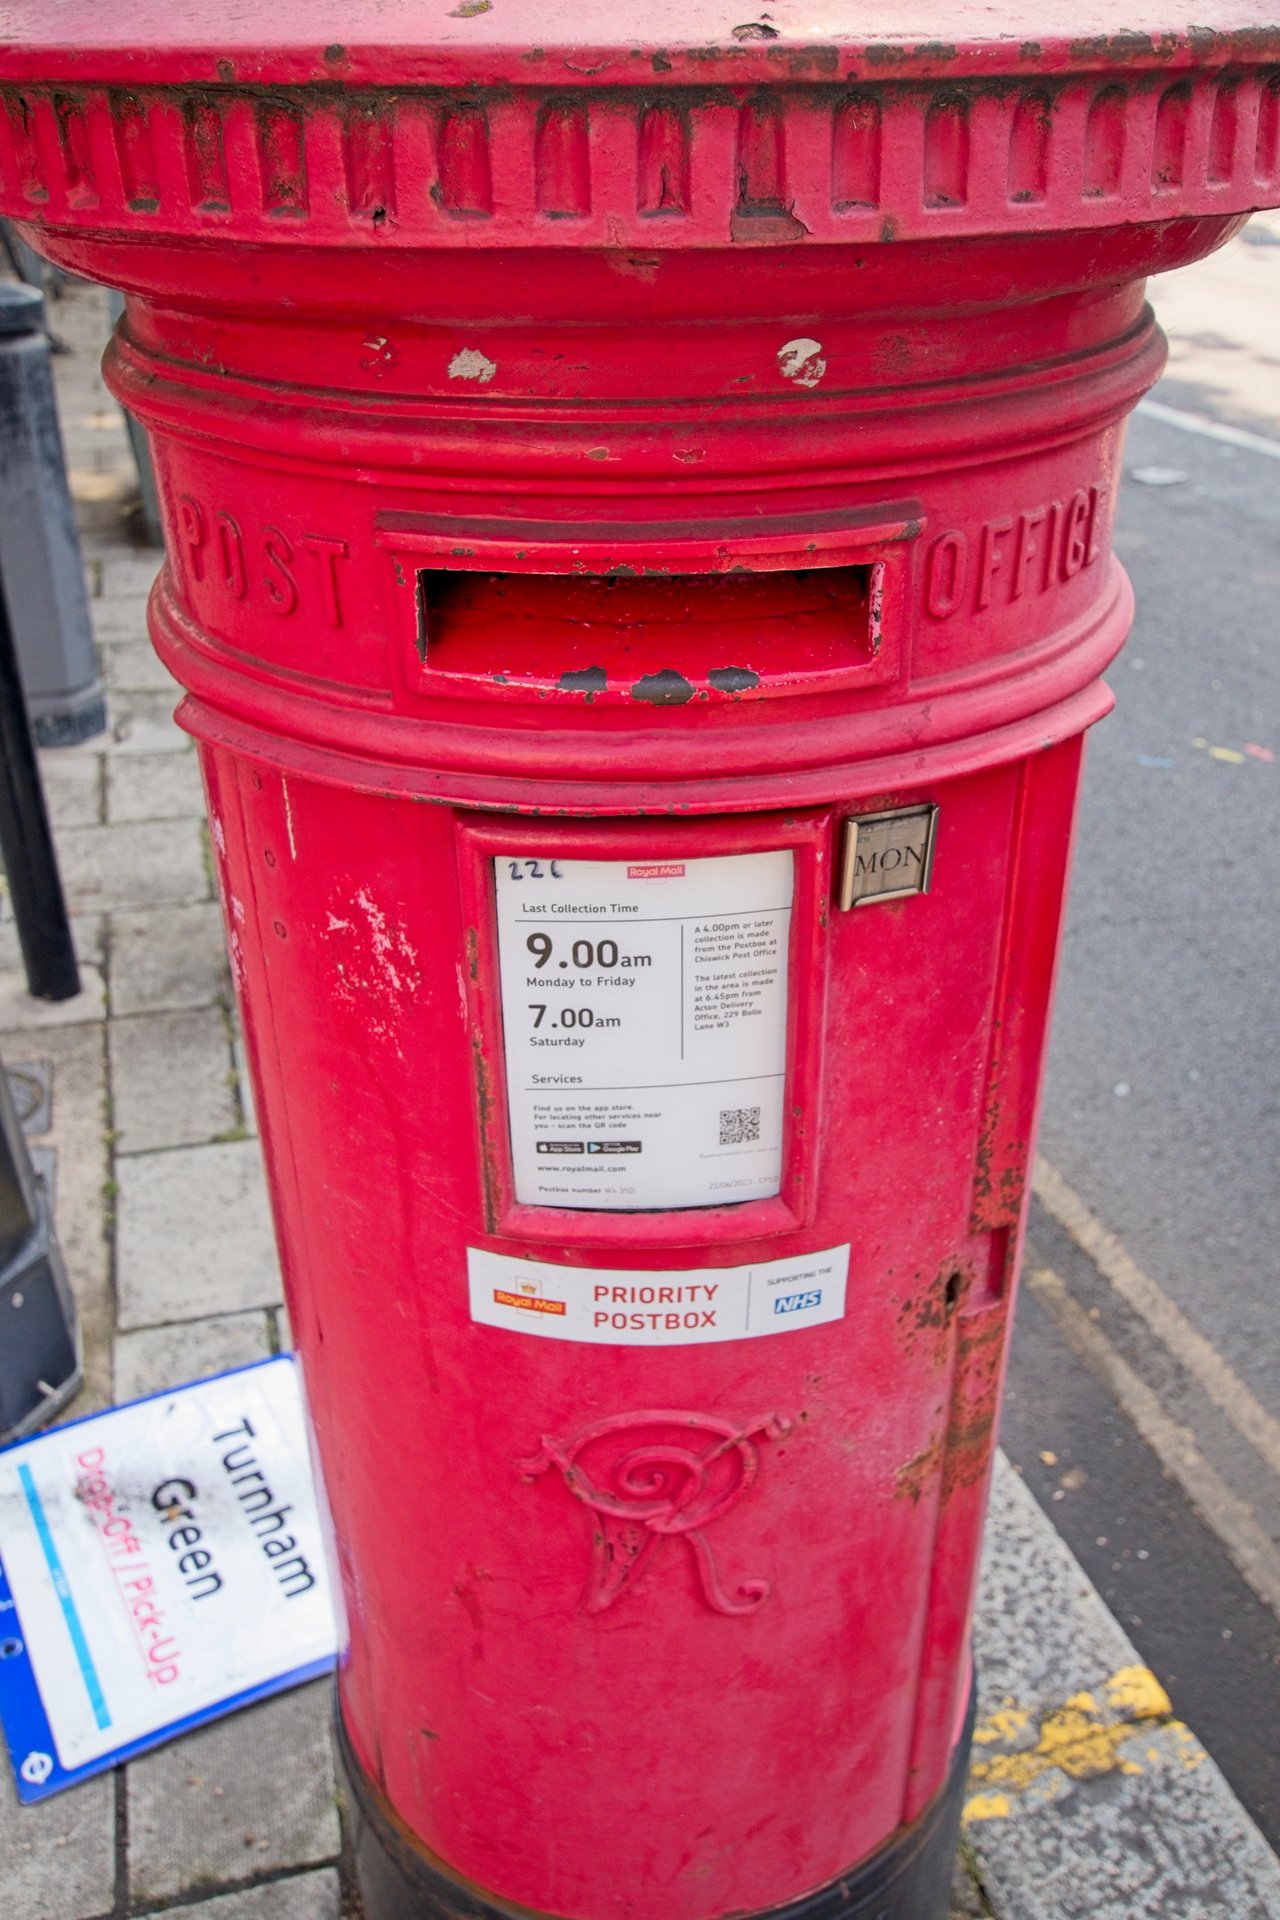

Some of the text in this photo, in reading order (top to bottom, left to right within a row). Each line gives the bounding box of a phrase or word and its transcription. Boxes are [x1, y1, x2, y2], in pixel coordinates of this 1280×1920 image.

[176, 496, 348, 629] POST
[854, 843, 926, 877] MON
[630, 865, 683, 878] Royal Mail
[522, 903, 639, 914] Last Collection Time
[695, 926, 700, 934] A
[703, 923, 740, 933] 4.00pm
[755, 920, 774, 928] later
[695, 934, 735, 944] collection
[747, 930, 770, 938] made
[526, 932, 652, 969] 9.00am
[735, 941, 766, 950] Postbox
[695, 949, 777, 963] Chiswick Post Office
[713, 973, 736, 981] latest
[739, 968, 778, 978] collection
[526, 976, 636, 988] Monday to Friday
[706, 993, 739, 1002] 6.45pm
[695, 1001, 753, 1012] Acton Delivery
[528, 1004, 621, 1028] 7.00am
[724, 1011, 739, 1019] 229
[695, 1021, 730, 1031] Lane W3
[529, 1037, 585, 1048] Saturday
[532, 1074, 583, 1084] Services
[538, 1165, 626, 1173] www.royalmail.com
[767, 1272, 816, 1286] SUPPORTING
[594, 1284, 719, 1304] PRIORITY
[776, 1290, 820, 1312] NHS
[496, 1291, 564, 1313] Royal Mail
[594, 1310, 717, 1330] POSTBOX
[213, 1417, 317, 1600] Turnham
[152, 1477, 224, 1602] Green
[124, 1575, 181, 1686] Pick-Up
